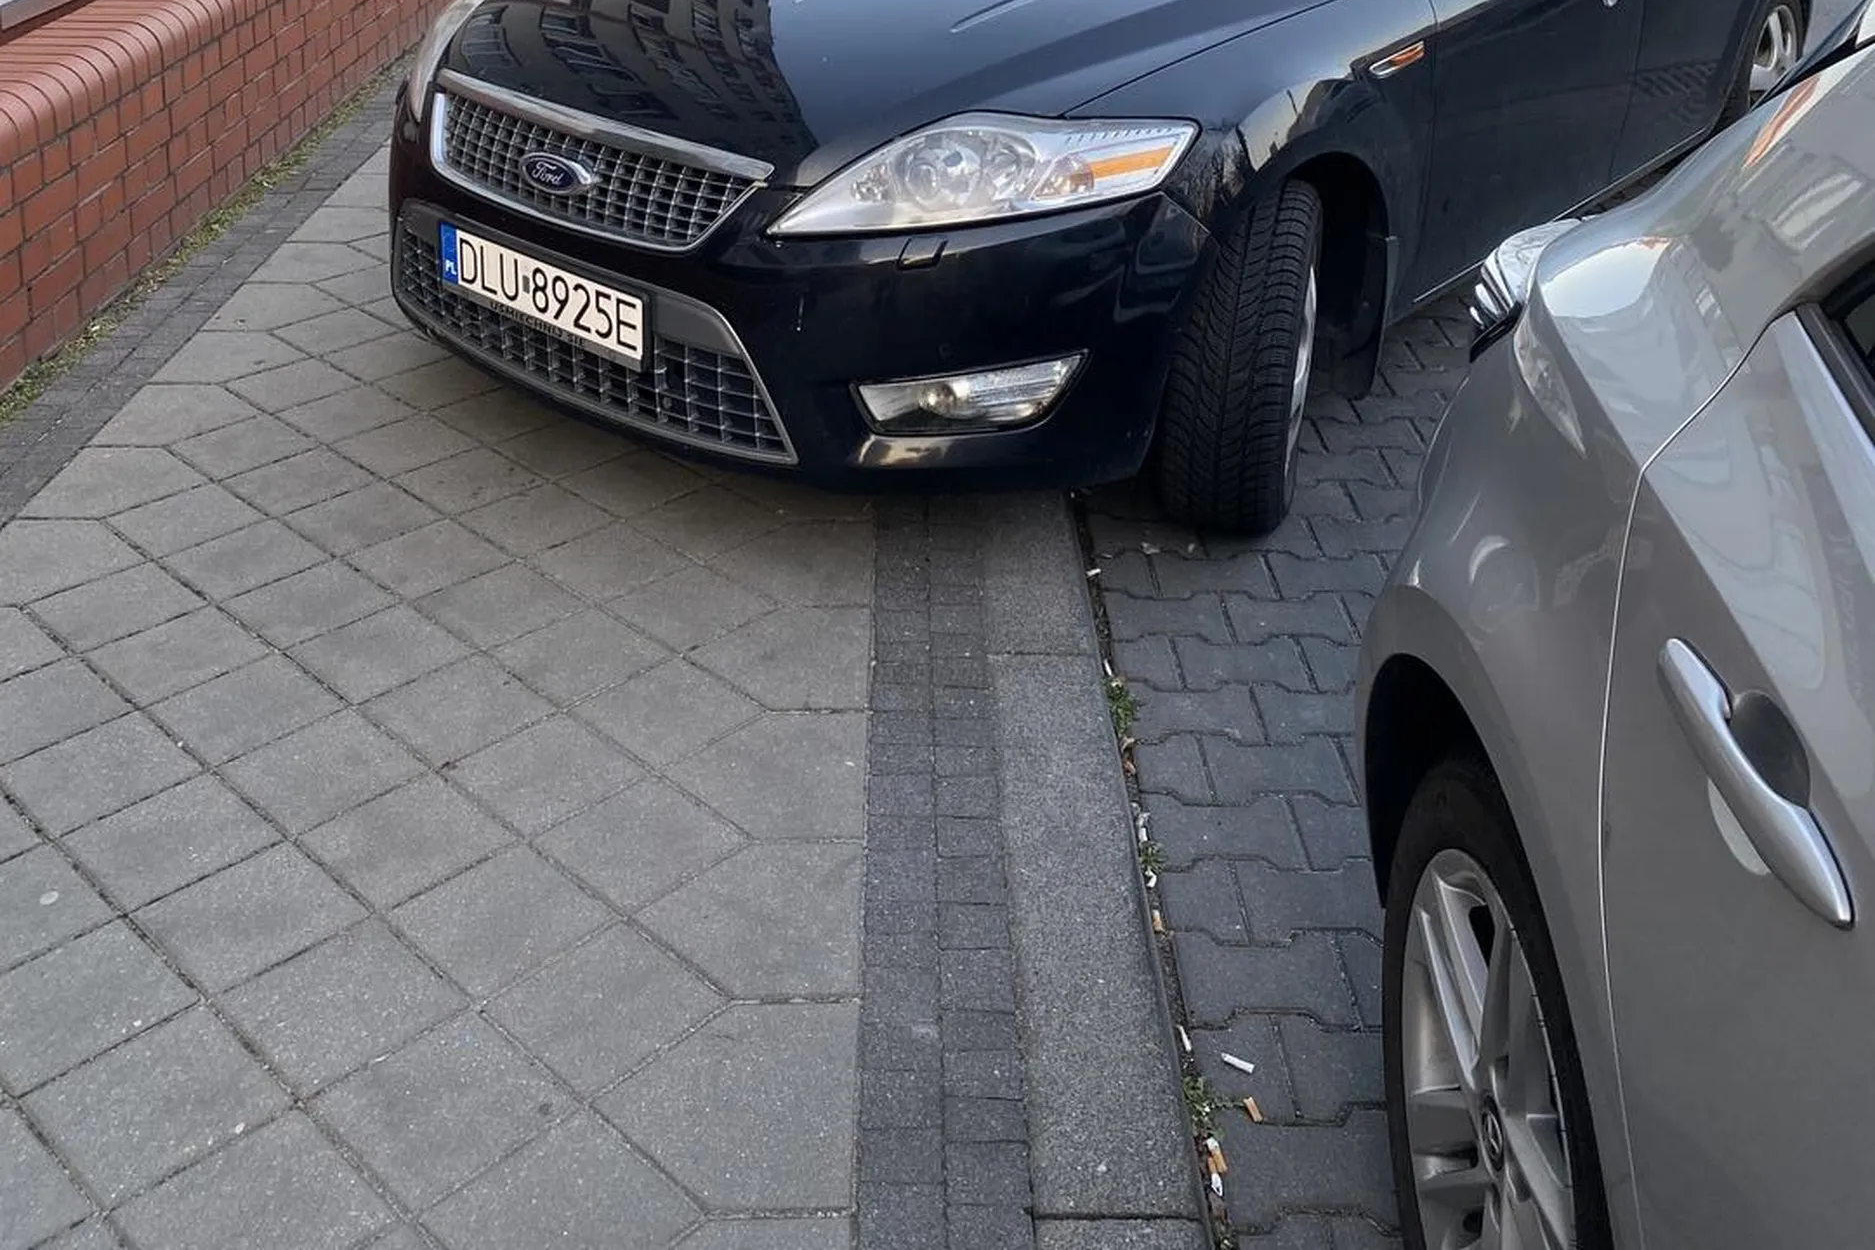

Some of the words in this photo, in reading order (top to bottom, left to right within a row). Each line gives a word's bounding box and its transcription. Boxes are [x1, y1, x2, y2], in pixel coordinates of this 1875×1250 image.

[531, 161, 565, 185] Ford
[445, 260, 457, 275] PL
[459, 238, 519, 301] DLU
[532, 267, 638, 351] 8925E
